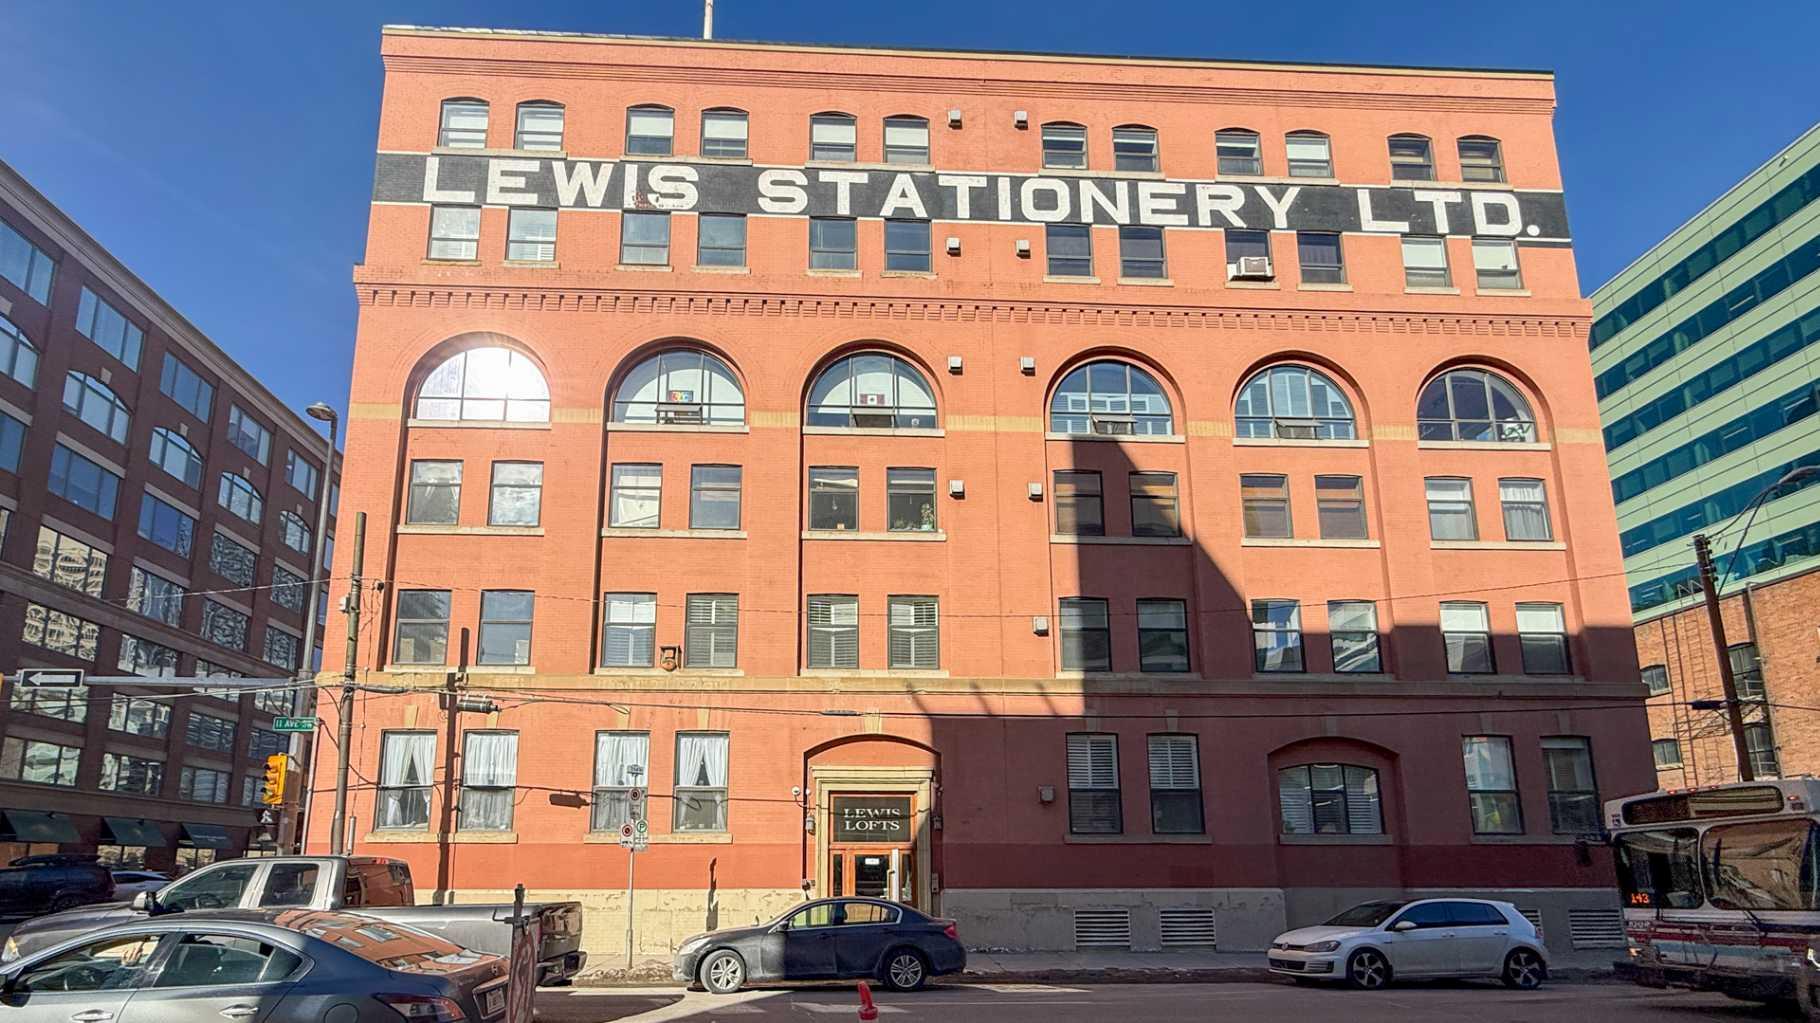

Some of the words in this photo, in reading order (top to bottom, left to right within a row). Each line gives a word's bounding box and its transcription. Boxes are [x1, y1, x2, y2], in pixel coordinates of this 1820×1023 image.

[423, 156, 699, 211] LEWIS
[758, 169, 1301, 229] STATIONERY
[1357, 188, 1541, 237] LTD.
[844, 808, 900, 818] LEWIS
[845, 820, 900, 831] LOFTS
